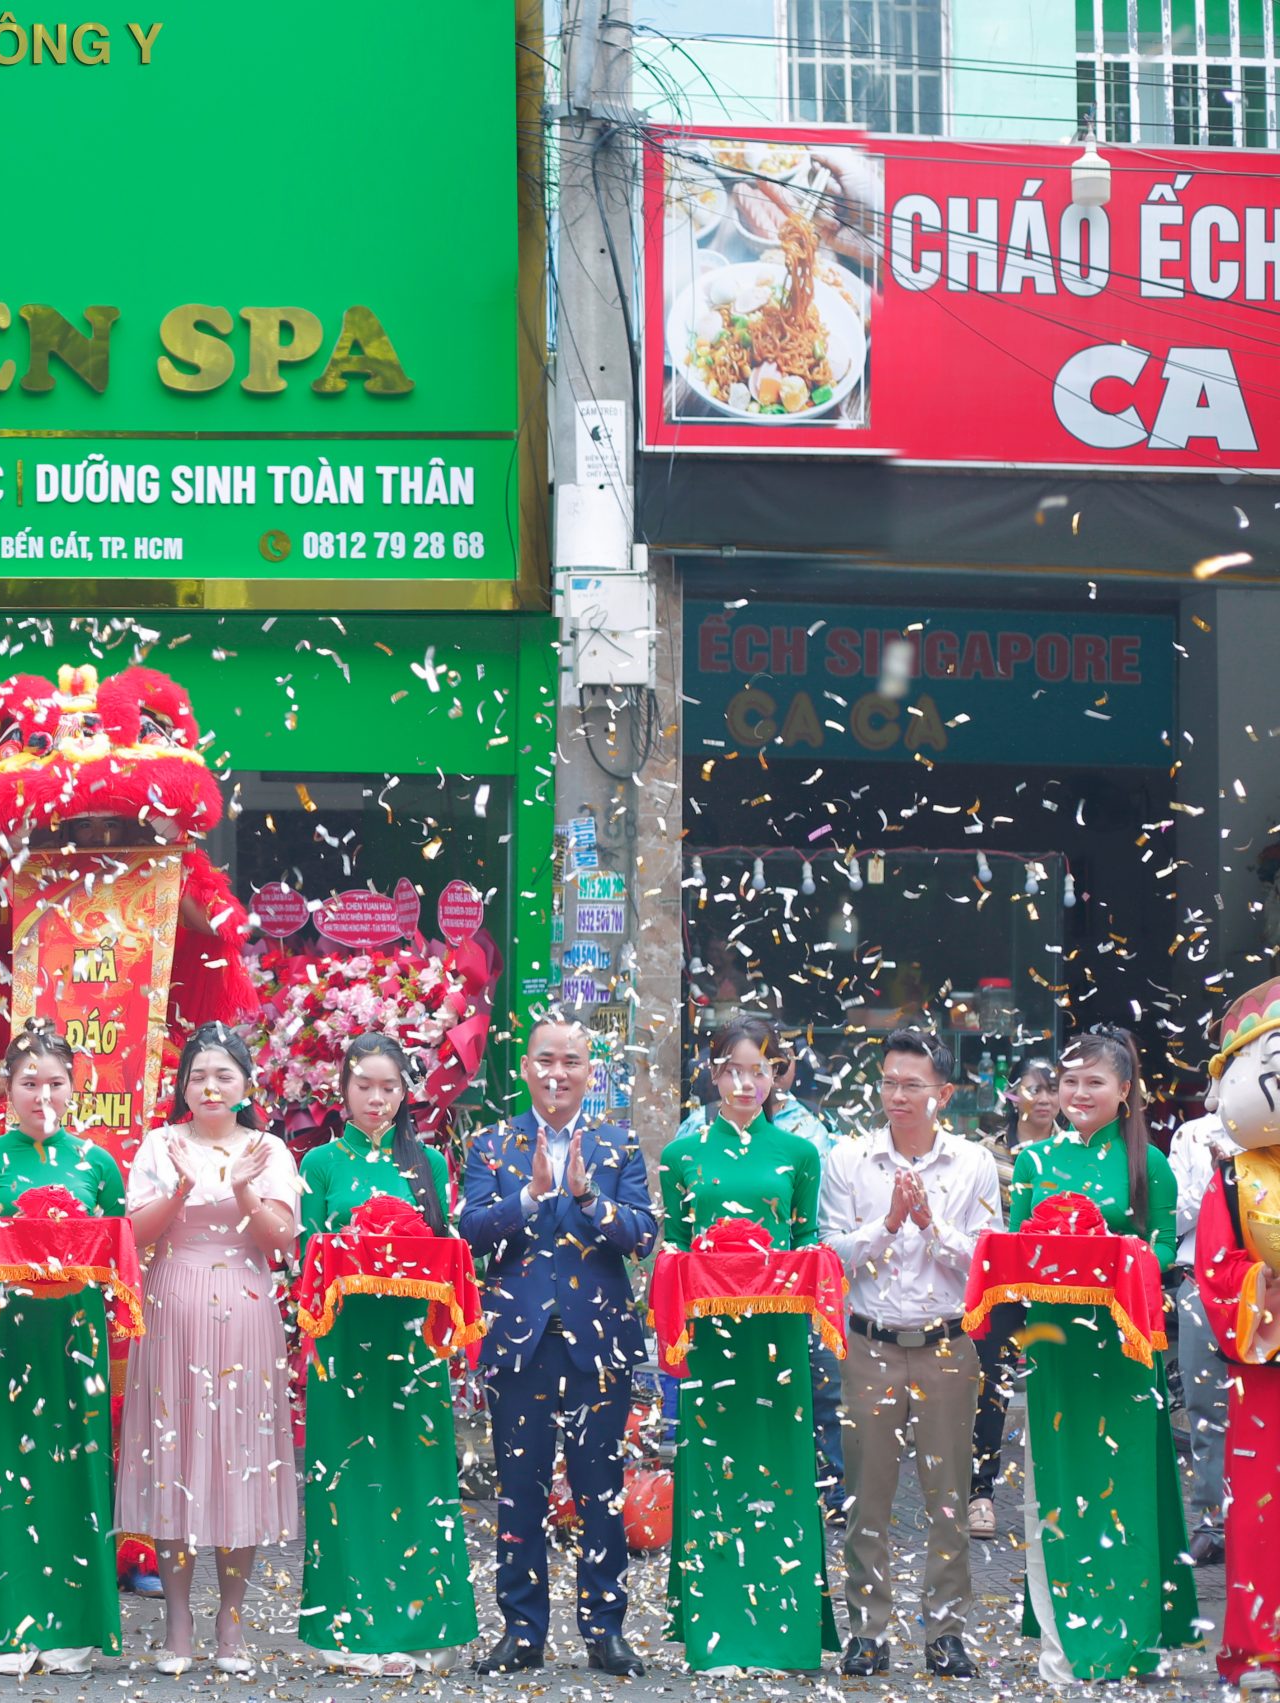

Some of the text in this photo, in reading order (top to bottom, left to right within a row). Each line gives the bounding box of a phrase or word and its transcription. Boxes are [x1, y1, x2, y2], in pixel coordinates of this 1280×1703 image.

[126, 22, 164, 64] Y
[890, 173, 1280, 301] CHÁO ẾCH
[157, 303, 416, 395] SPA
[1052, 343, 1260, 452] CA
[36, 453, 474, 505] DƯỠNG SINH TOÀN THÂN
[1, 527, 44, 559] BẾN
[50, 531, 93, 561] CÁT,
[99, 536, 128, 559] TP.
[134, 537, 183, 560] HCM
[303, 532, 485, 559] 0812 79 28 68
[697, 610, 1142, 684] ẾCH SINGAPORE
[726, 688, 948, 752] CA CA
[65, 1007, 118, 1054] ĐÁO
[58, 1080, 133, 1128] HÀNH
